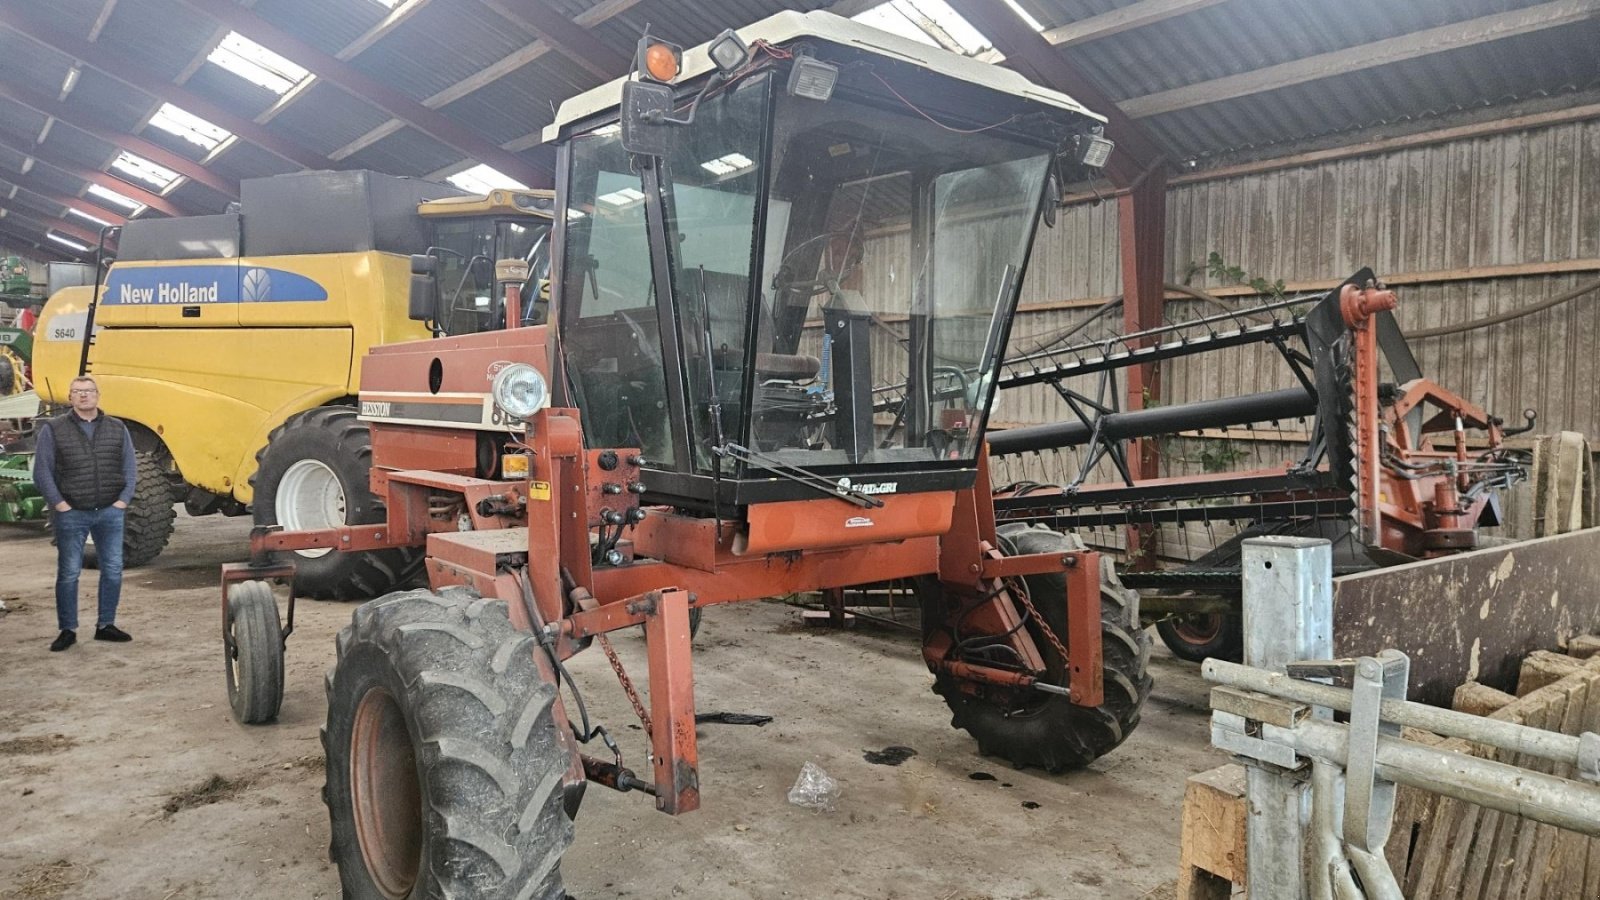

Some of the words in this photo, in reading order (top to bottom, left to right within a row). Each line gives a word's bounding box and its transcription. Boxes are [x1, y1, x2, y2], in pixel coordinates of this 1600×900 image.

[120, 283, 154, 304] New
[158, 281, 218, 303] Holland
[54, 328, 76, 339] S640
